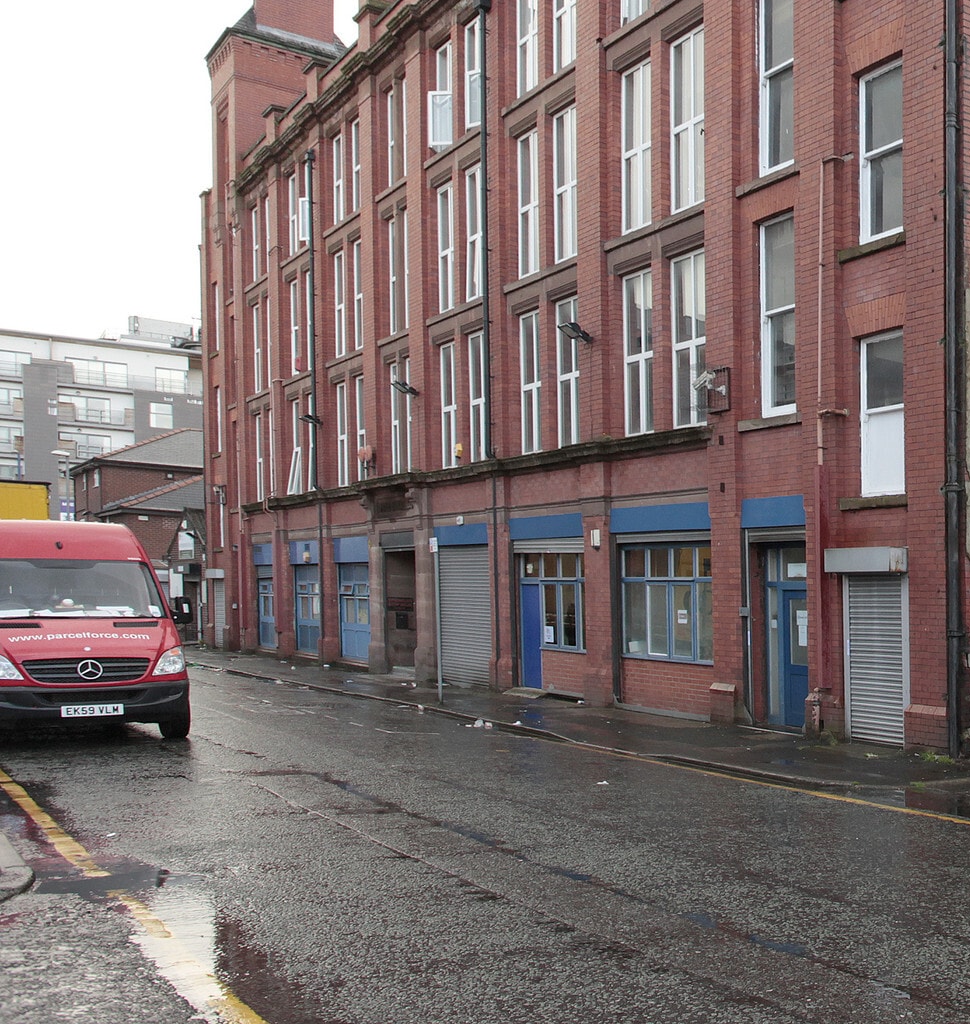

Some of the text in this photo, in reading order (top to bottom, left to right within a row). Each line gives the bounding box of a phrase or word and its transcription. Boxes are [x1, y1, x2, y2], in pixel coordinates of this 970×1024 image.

[8, 632, 150, 643] www.parcelforce.com
[66, 705, 119, 716] EK59 VLM
